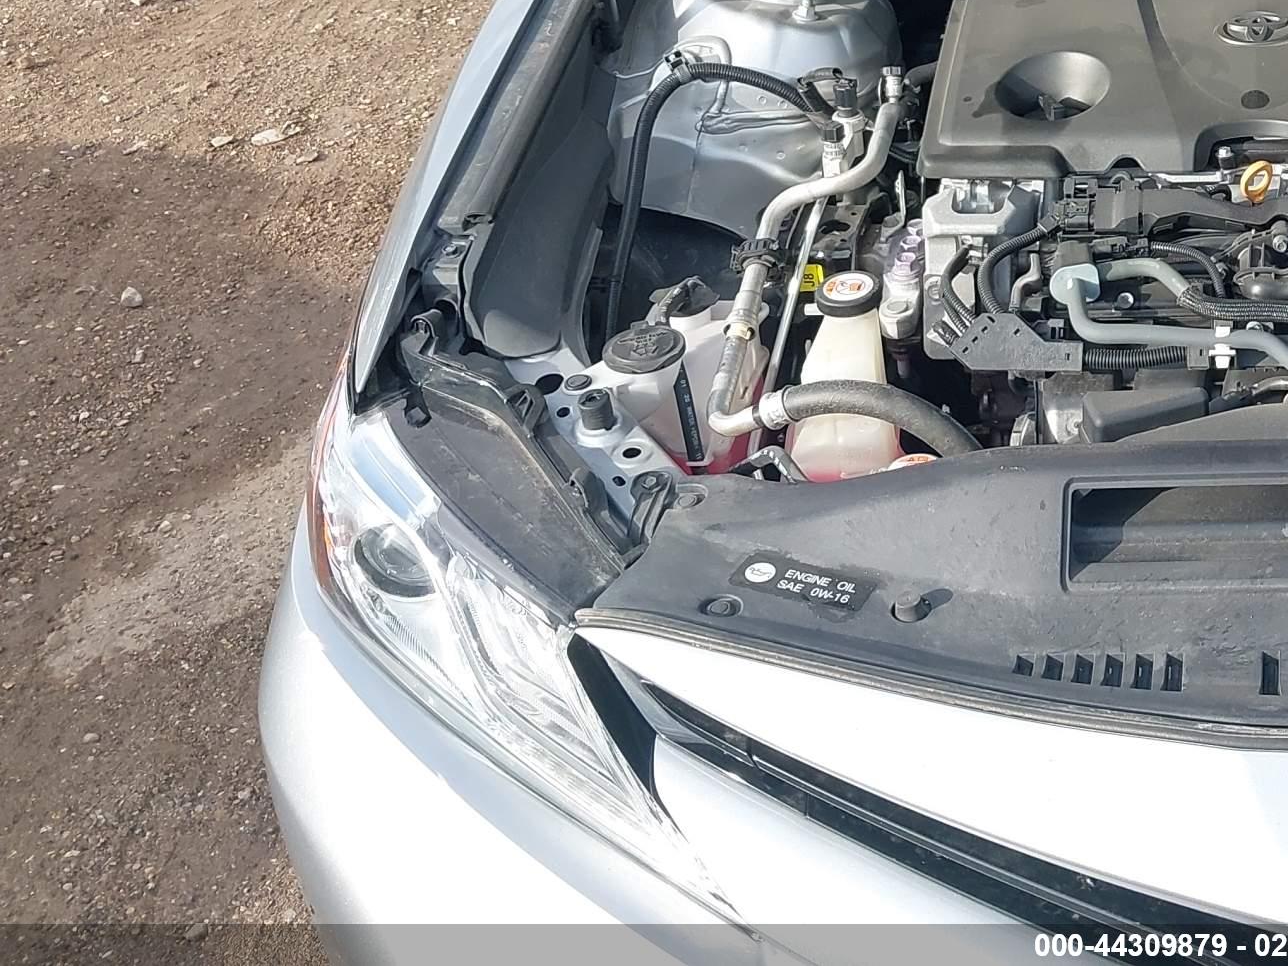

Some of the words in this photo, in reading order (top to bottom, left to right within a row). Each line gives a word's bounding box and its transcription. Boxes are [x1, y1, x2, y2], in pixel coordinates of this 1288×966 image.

[803, 273, 815, 287] J8
[776, 579, 805, 593] SAE
[809, 587, 850, 604] 0W-16
[784, 569, 832, 588] ENGINE
[837, 581, 857, 593] OIL
